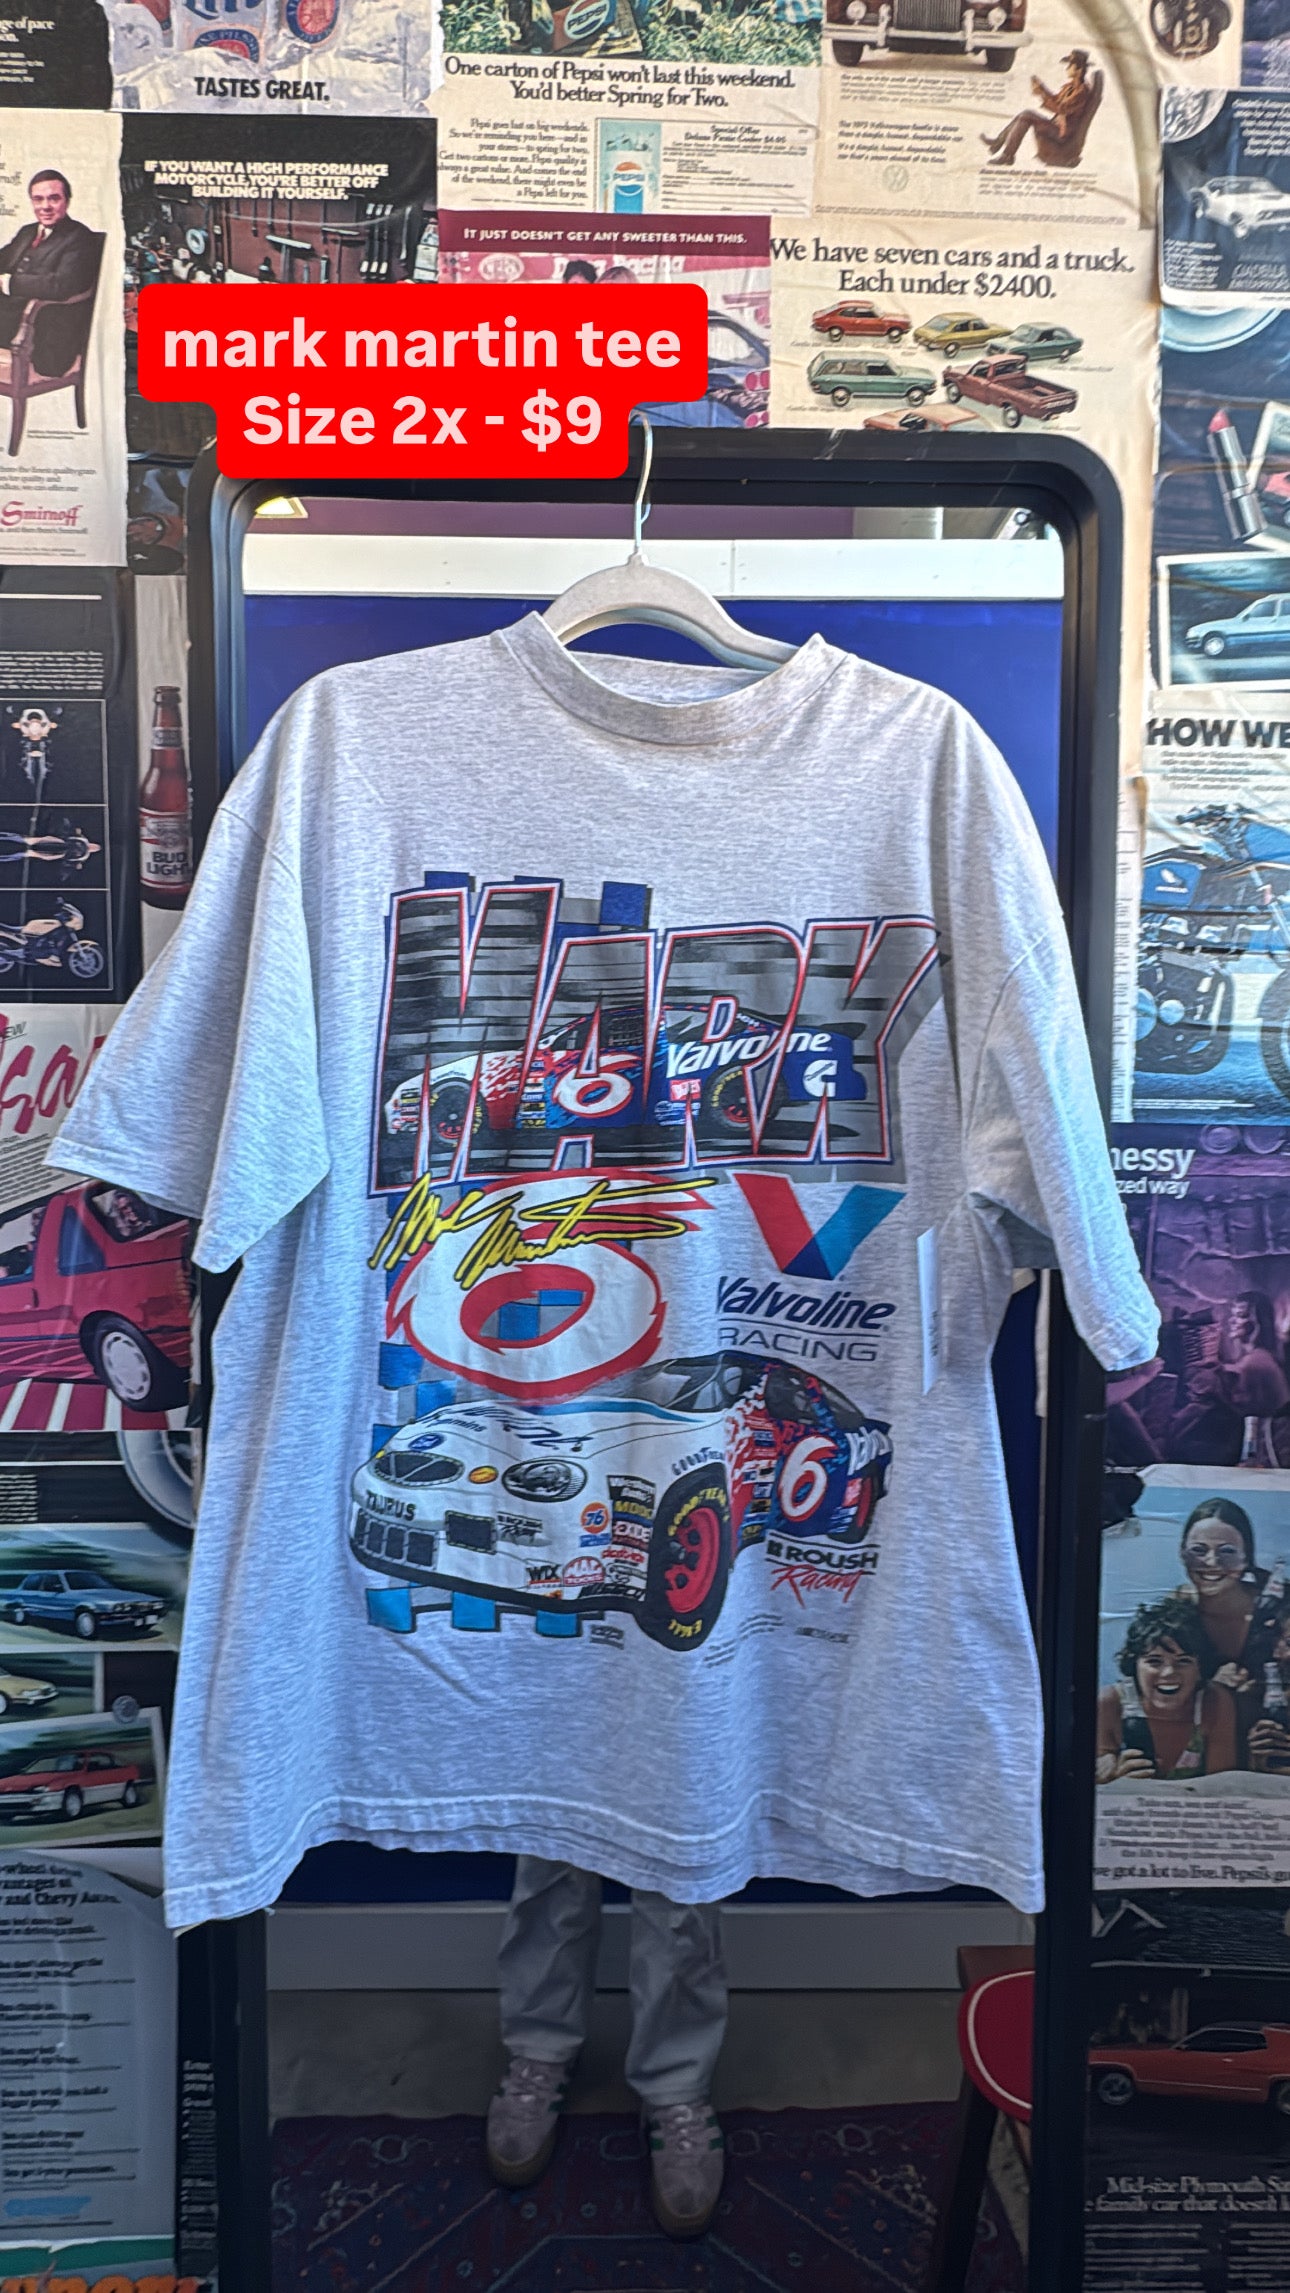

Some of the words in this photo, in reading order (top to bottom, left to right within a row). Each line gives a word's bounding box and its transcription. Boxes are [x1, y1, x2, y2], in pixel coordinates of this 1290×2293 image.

[445, 56, 481, 76] One
[484, 63, 538, 78] carton
[542, 61, 560, 79] of
[562, 61, 604, 84] Pepsi
[607, 65, 649, 83] won't
[653, 65, 681, 84] last
[685, 66, 714, 85] this
[717, 68, 796, 88] weekend.
[194, 77, 260, 99] TASTES
[266, 80, 330, 101] GREAT.
[510, 80, 552, 100] You'd
[557, 82, 606, 102] better
[607, 84, 664, 108] Spring
[666, 87, 691, 105] for
[691, 87, 729, 107] Two.
[144, 160, 158, 172] IF
[159, 160, 189, 172] YOU
[190, 161, 233, 173] WANT
[234, 161, 245, 174] A
[246, 162, 283, 175] HIGH
[285, 163, 390, 177] PERFORMANCE
[154, 172, 249, 187] MOTORCYCLE,
[249, 174, 299, 187] YOU'RE
[300, 175, 351, 188] BETTER
[352, 177, 379, 188] OFF
[192, 186, 259, 199] BUILDING
[261, 187, 274, 199] IT
[275, 187, 349, 200] YOURSELF.
[464, 228, 477, 239] IT
[479, 229, 507, 240] JUST
[510, 230, 563, 241] DOESN'T
[567, 230, 591, 242] GET
[593, 230, 620, 242] ANY
[622, 231, 677, 243] SWEETER
[679, 232, 714, 243] THAN
[715, 233, 748, 244] THIS.
[771, 238, 807, 260] We
[812, 237, 868, 262] have
[874, 247, 939, 265] seven
[944, 249, 992, 266] cars
[996, 244, 1041, 269] and
[1046, 253, 1059, 270] a
[1064, 246, 1135, 273] truck.
[839, 267, 894, 292] Each
[900, 270, 970, 294] under
[974, 271, 1057, 298] $2400.
[1, 501, 83, 526] Smirnoff
[1146, 718, 1237, 747] HOW
[152, 852, 187, 863] BUD
[369, 878, 938, 1196] MARK
[1148, 1180, 1190, 1199] way
[386, 1168, 718, 1404] 6
[716, 1276, 896, 1330] Valvoline
[718, 1326, 878, 1362] RACING
[779, 1434, 838, 1522] 6
[584, 1510, 605, 1527] 76
[785, 1545, 878, 1568] ROUSH
[526, 1565, 561, 1581] WIX
[770, 1564, 865, 1610] Racing
